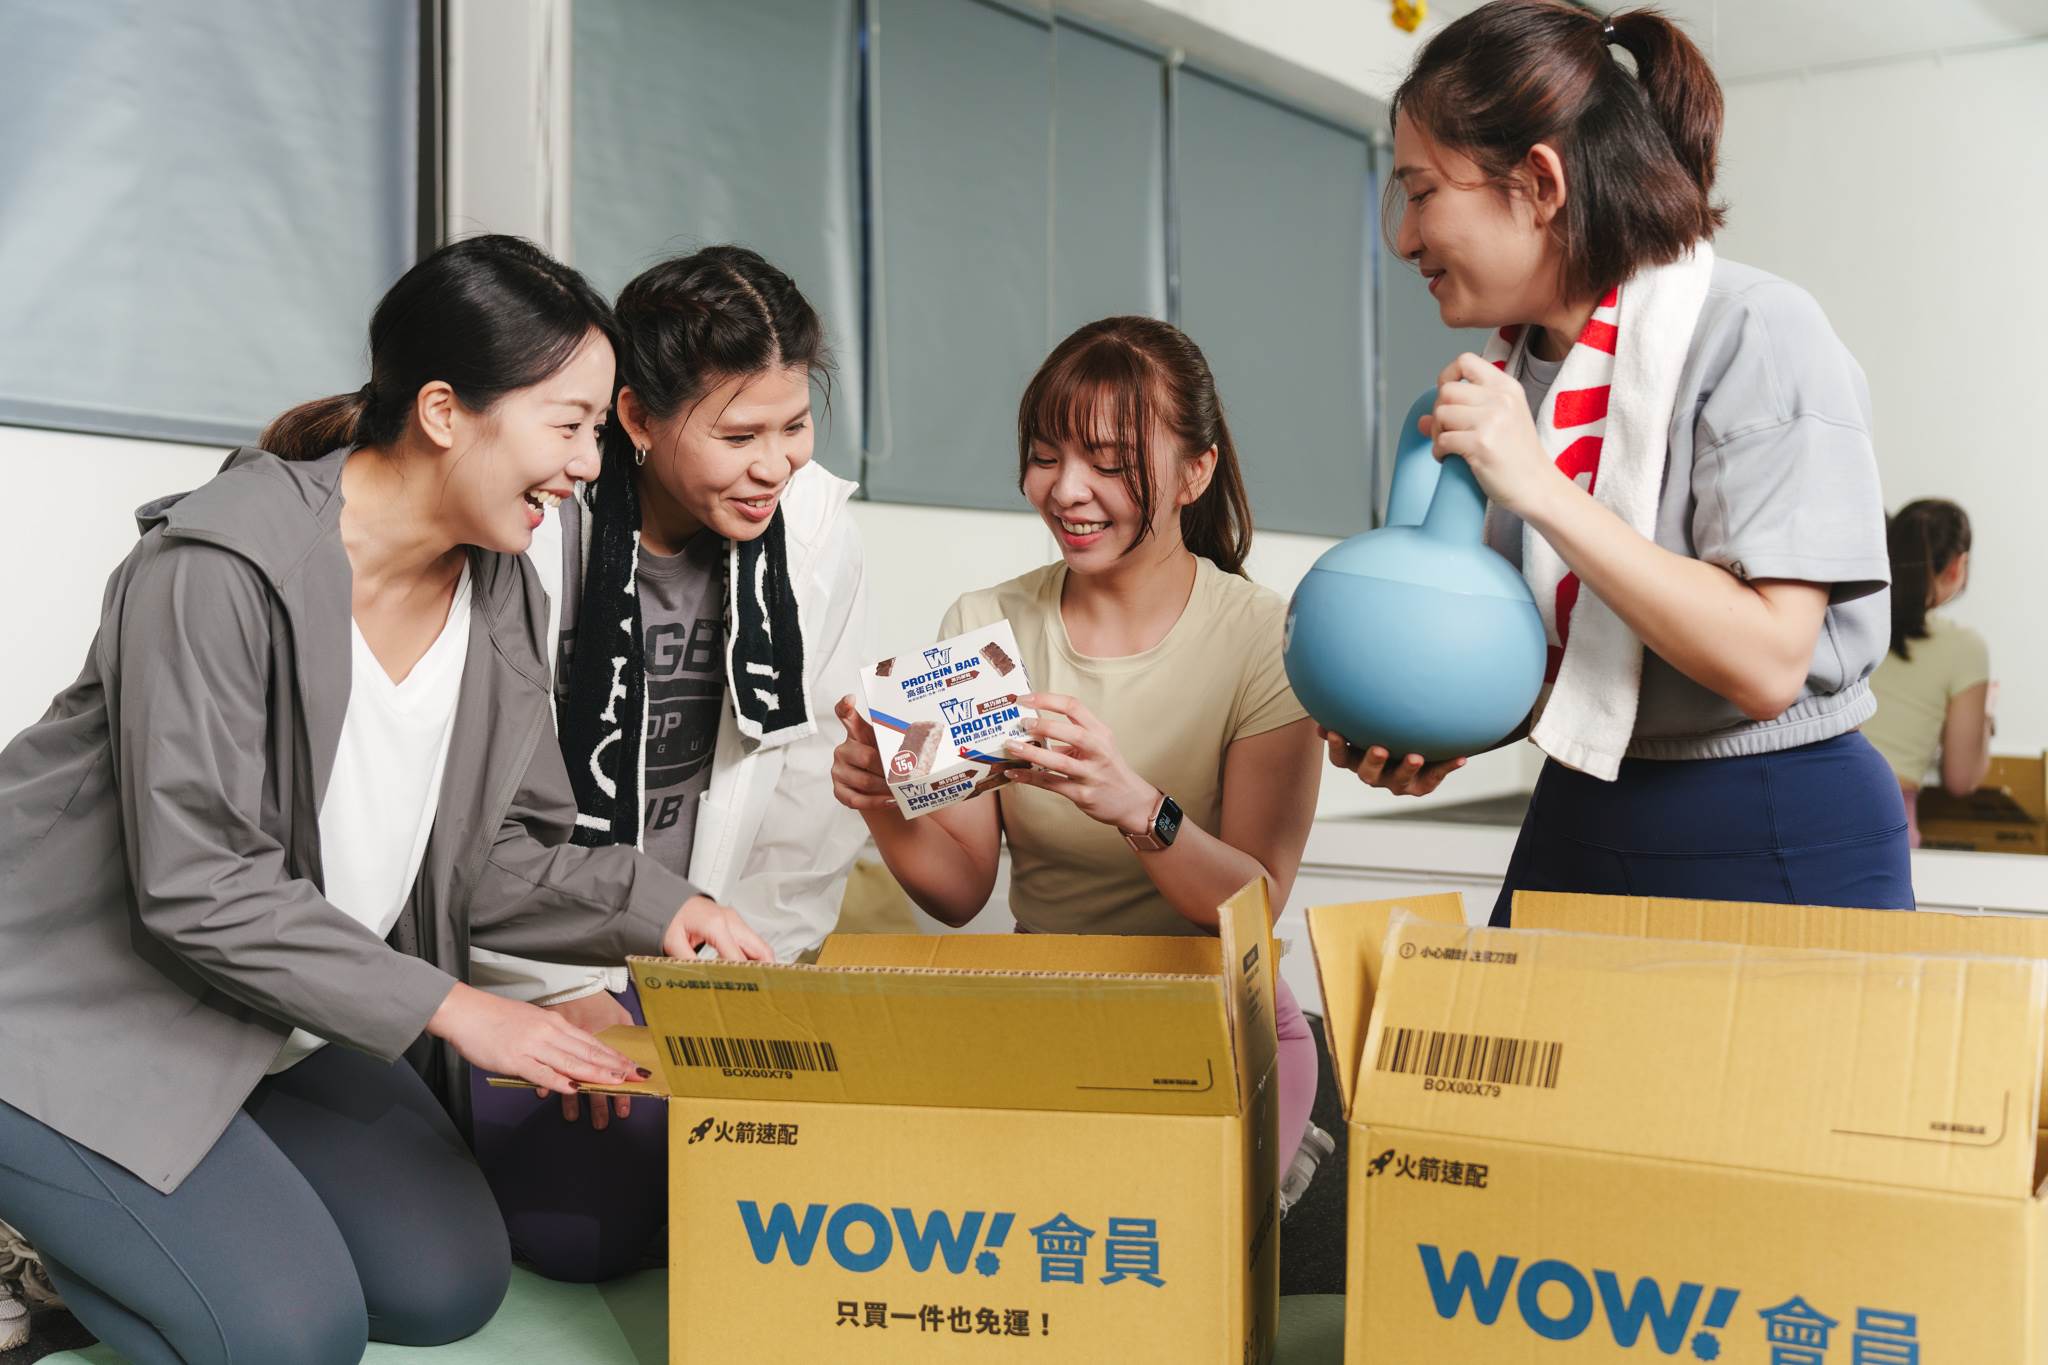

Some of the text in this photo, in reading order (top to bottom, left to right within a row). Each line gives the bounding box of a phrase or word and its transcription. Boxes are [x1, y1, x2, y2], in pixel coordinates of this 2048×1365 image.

[901, 665, 953, 690] PROTEIN
[954, 656, 980, 671] BAR
[950, 706, 1020, 738] PROTEIN
[954, 735, 972, 746] BAR
[895, 758, 914, 773] 15g
[907, 780, 973, 807] PROTEIN
[910, 803, 929, 811] BAR
[1423, 1077, 1501, 1098] BOX00X79
[714, 1119, 799, 1147] 火箭速配
[1395, 1153, 1489, 1189] 火箭速配
[736, 1200, 1016, 1278] WOW!
[1029, 1213, 1167, 1289] 會員
[1416, 1243, 1741, 1362] WOW!
